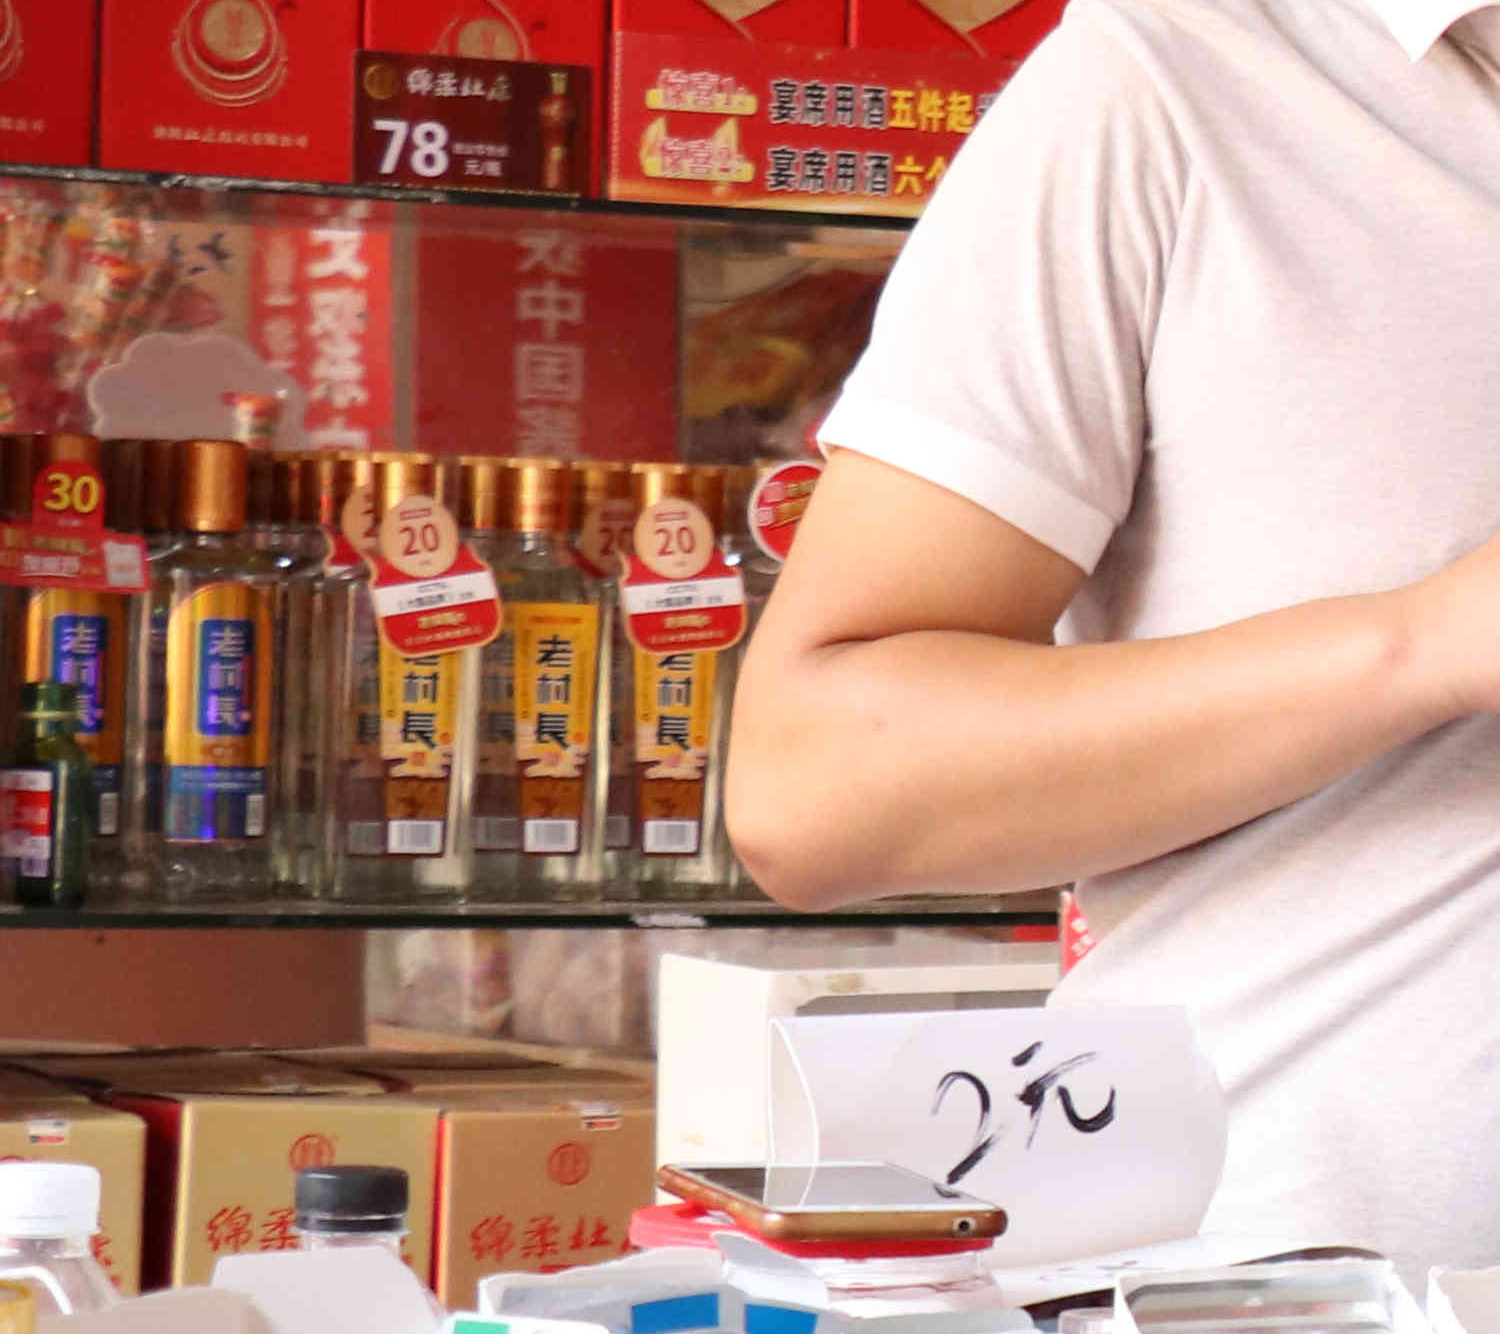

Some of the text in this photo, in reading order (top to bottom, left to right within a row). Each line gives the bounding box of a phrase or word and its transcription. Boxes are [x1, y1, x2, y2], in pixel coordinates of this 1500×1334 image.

[371, 118, 450, 179] 78
[42, 473, 99, 514] 30
[397, 521, 439, 556] 20
[653, 522, 696, 557] 20
